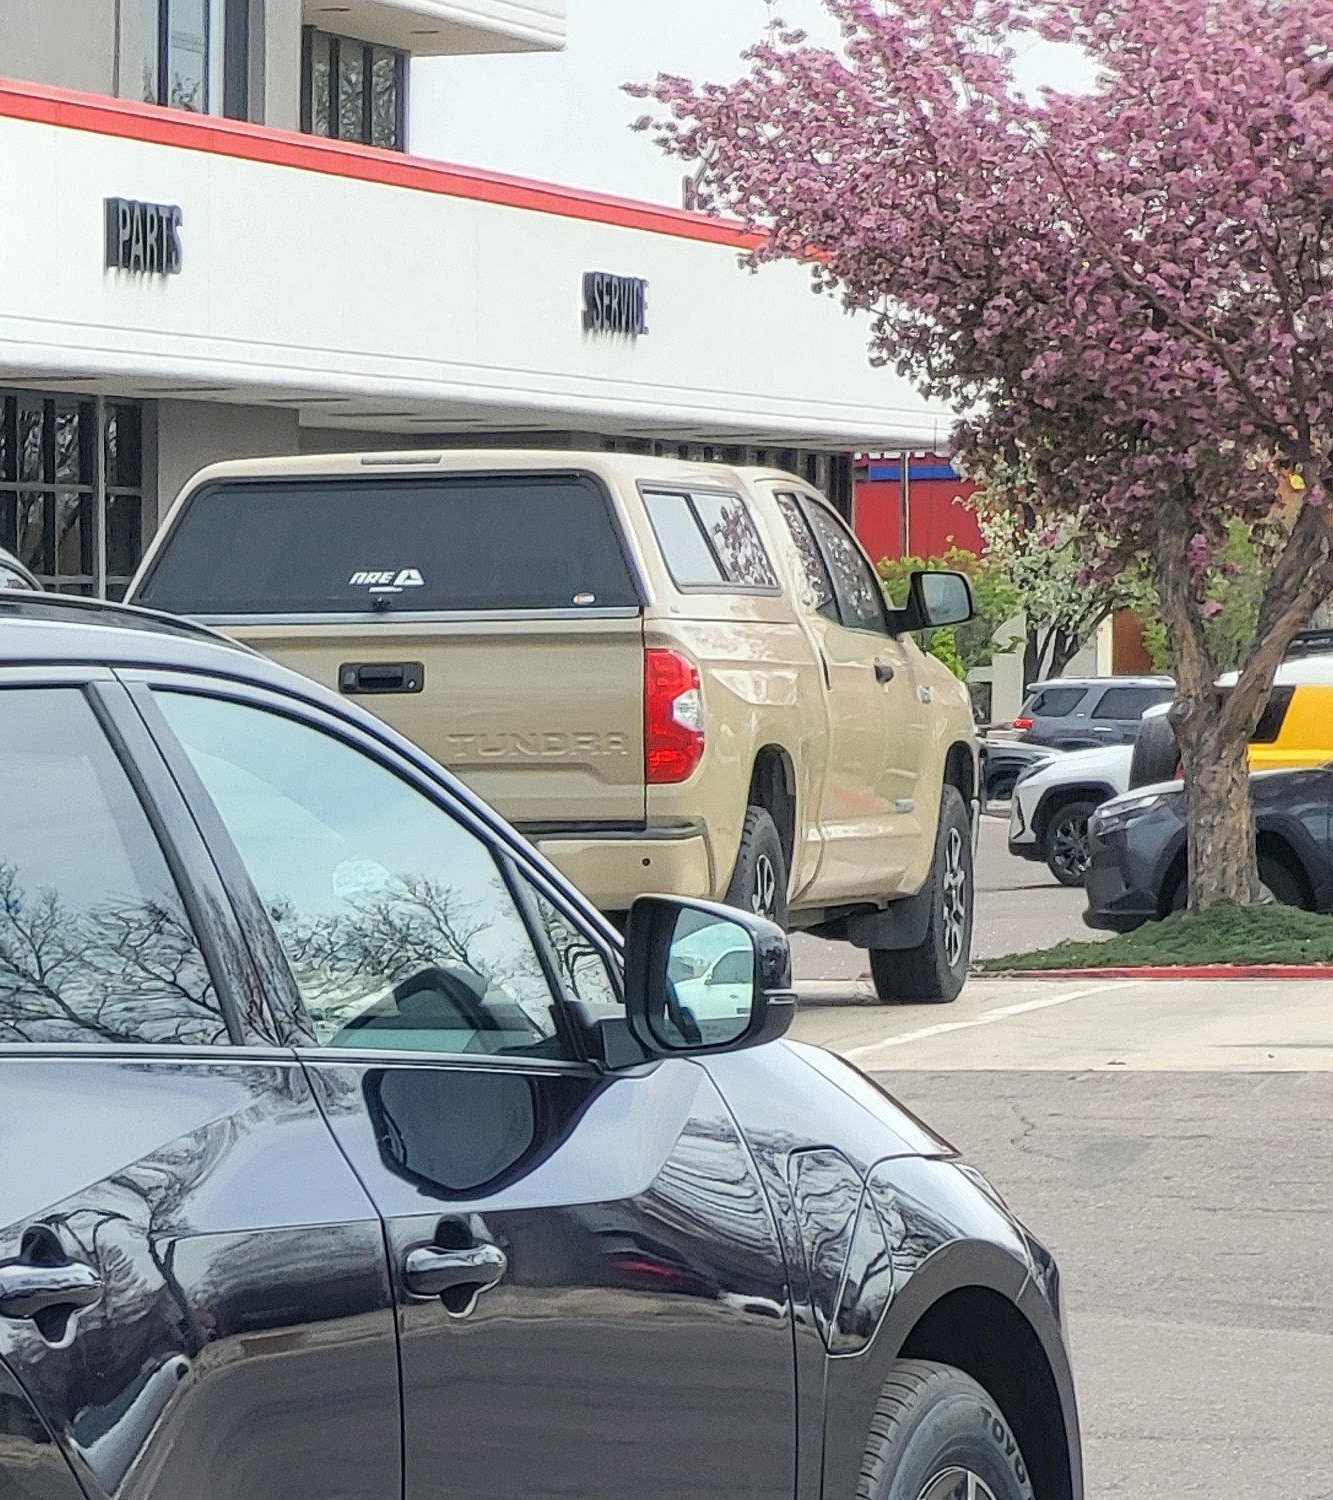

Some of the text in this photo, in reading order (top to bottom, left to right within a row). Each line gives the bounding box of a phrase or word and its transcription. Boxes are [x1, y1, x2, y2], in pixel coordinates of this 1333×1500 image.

[105, 198, 182, 274] PARTS
[583, 272, 648, 333] SERVICE
[448, 732, 629, 758] TUNDRA
[980, 1406, 1026, 1485] TOYO
